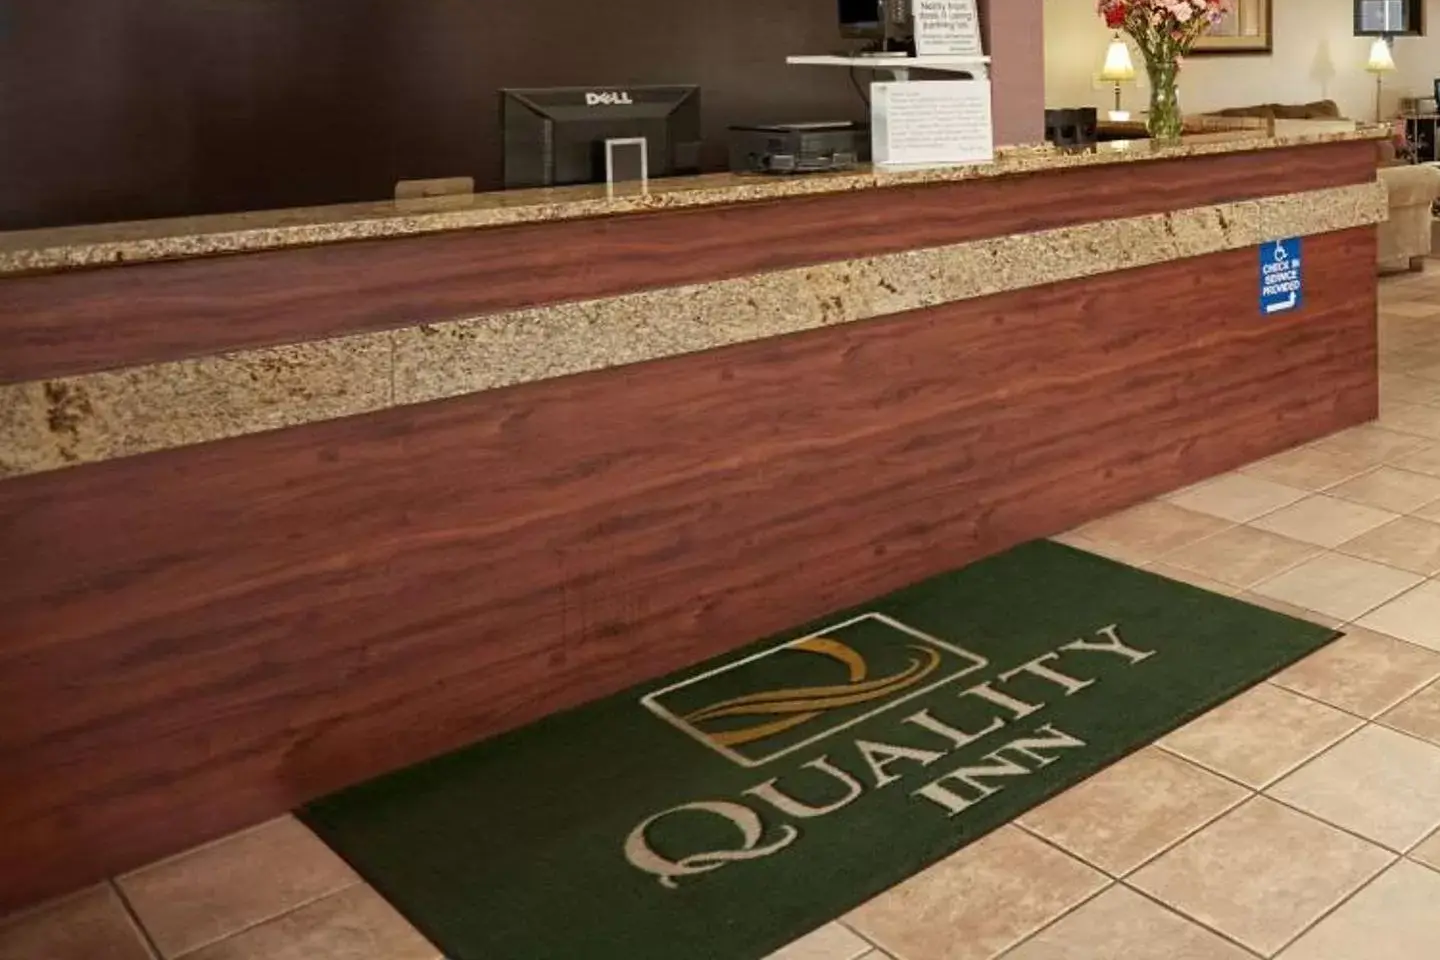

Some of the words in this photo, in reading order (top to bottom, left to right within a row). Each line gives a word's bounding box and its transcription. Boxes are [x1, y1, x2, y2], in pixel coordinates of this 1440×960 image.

[585, 91, 633, 105] DELL
[1262, 260, 1290, 275] CHECK
[1291, 258, 1300, 268] IN
[1264, 269, 1298, 285] SERVICE
[1262, 279, 1301, 296] PROVIDED
[623, 623, 1157, 889] QUALITY
[911, 723, 1087, 819] INN
